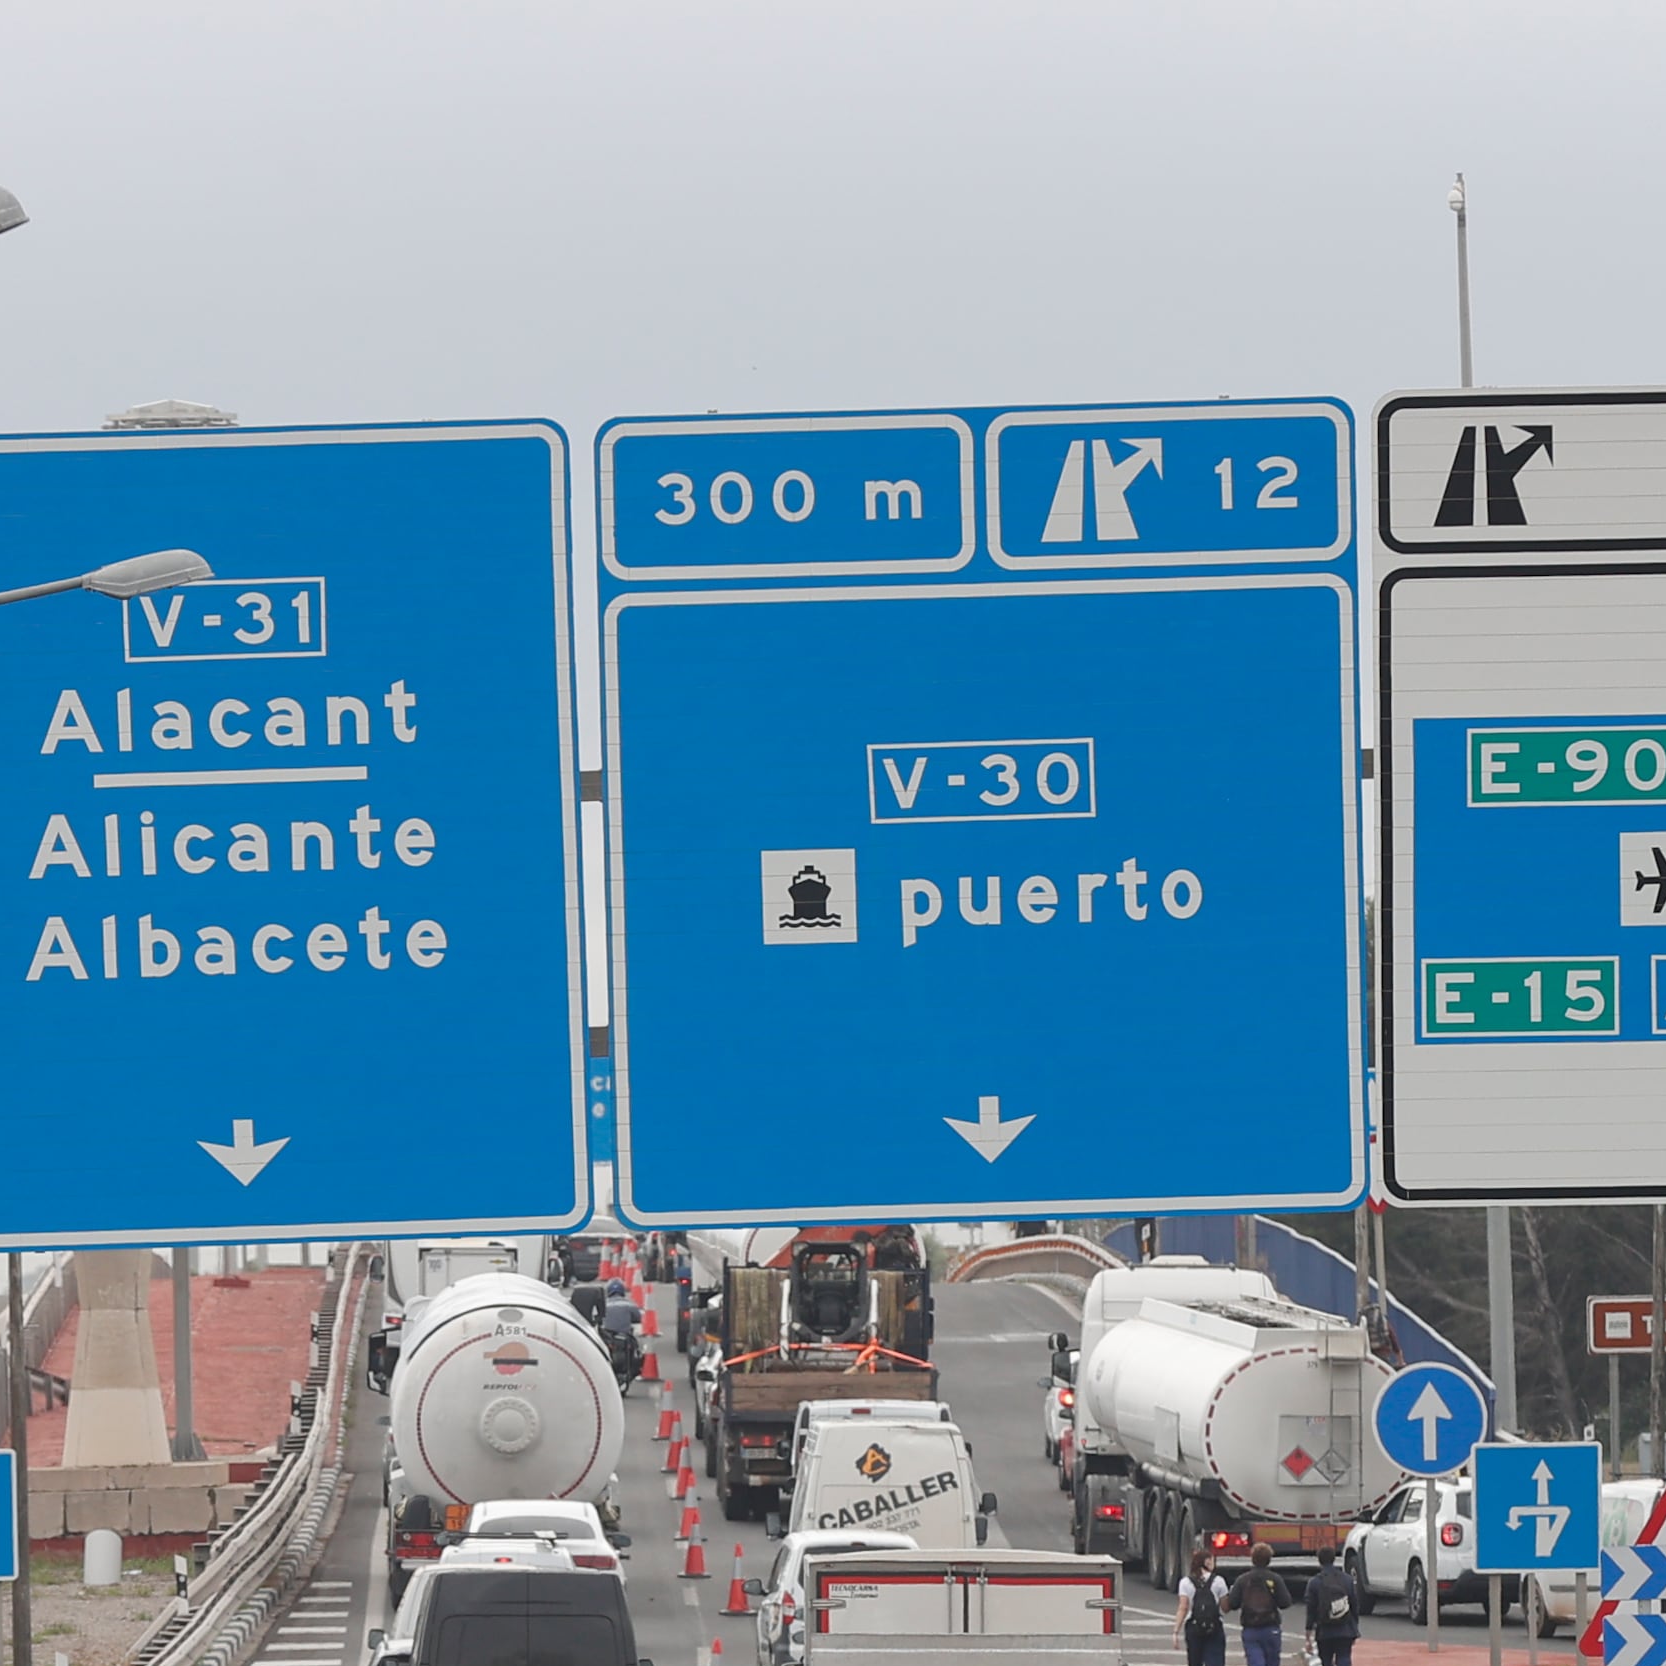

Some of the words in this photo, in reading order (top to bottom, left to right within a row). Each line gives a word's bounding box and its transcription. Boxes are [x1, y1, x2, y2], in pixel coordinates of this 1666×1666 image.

[654, 469, 816, 525] 300
[864, 479, 923, 521] m
[1215, 456, 1299, 510] 12
[140, 591, 312, 648] V-31
[39, 679, 418, 755] Alacant
[881, 752, 1080, 809] V-30
[28, 804, 437, 880] Alicante
[900, 857, 1203, 948] puerto
[25, 906, 448, 982] Albacete
[1434, 969, 1606, 1024] E-15
[818, 1470, 959, 1529] CABALLER
